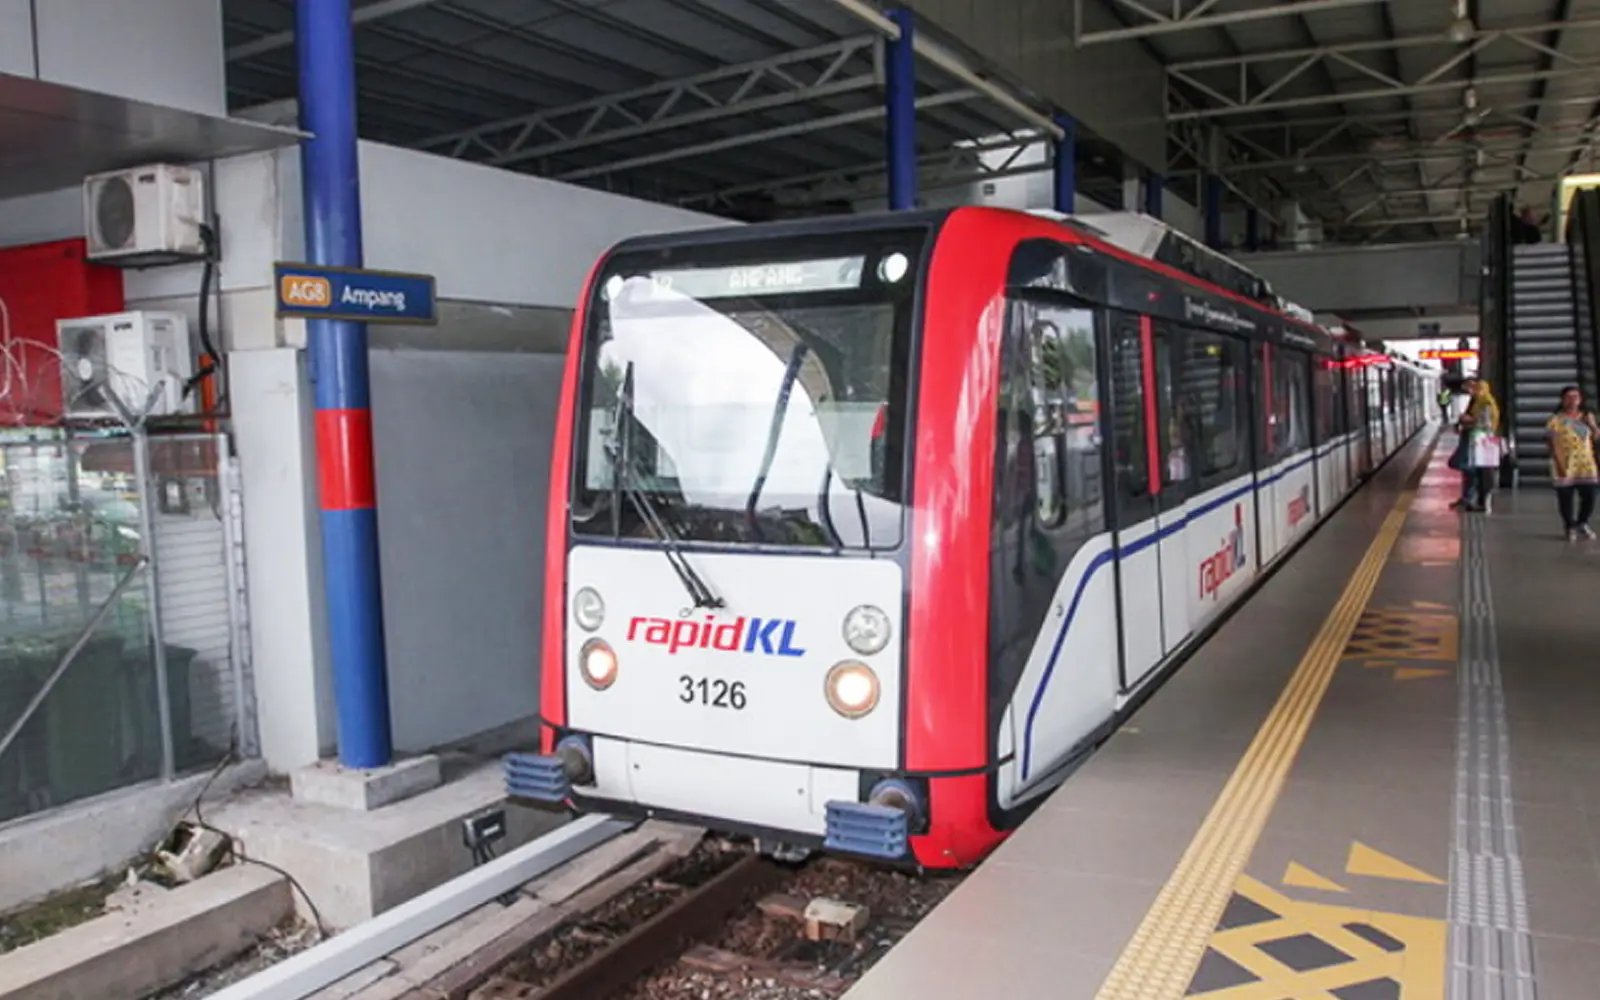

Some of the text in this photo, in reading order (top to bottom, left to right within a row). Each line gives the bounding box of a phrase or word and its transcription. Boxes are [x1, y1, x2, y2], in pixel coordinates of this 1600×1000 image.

[288, 280, 406, 312] AG8 Ampang
[627, 615, 806, 657] rapidKL
[678, 675, 747, 710] 3126
